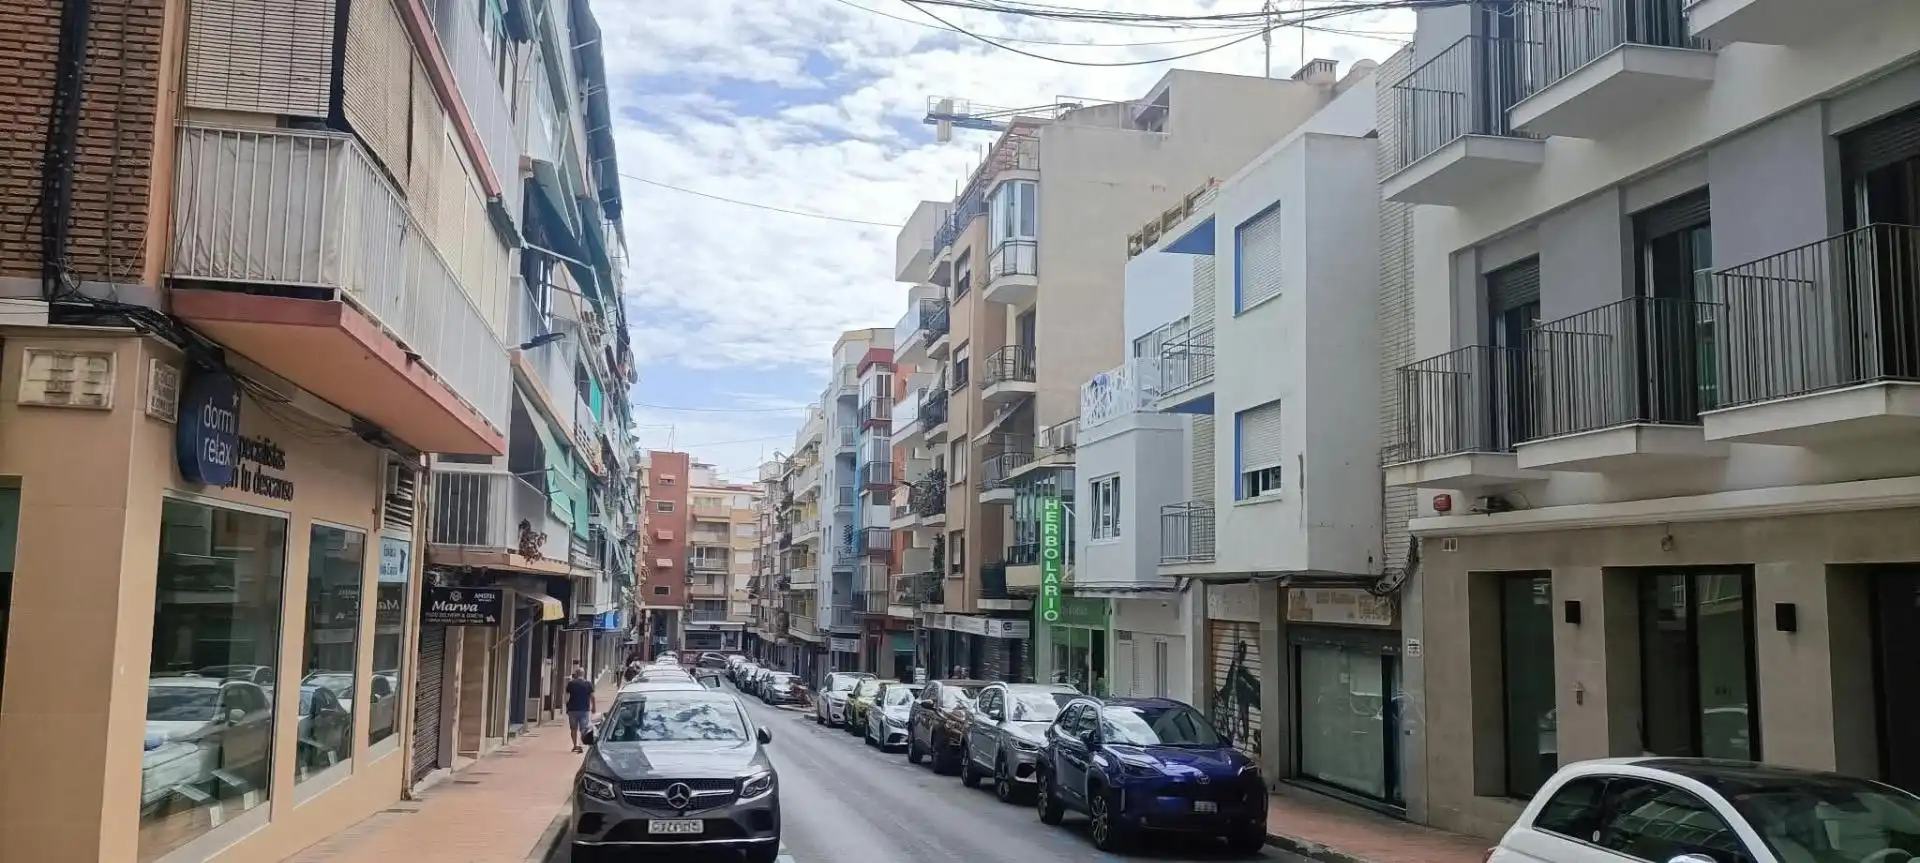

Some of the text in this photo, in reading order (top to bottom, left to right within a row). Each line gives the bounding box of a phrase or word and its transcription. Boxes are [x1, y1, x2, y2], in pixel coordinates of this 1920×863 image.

[203, 397, 235, 435] dormi
[203, 434, 232, 466] relax
[236, 434, 286, 471] pecialistas
[241, 463, 251, 493] tu
[253, 465, 294, 501] descanso
[1044, 499, 1058, 621] HERBOLARIO
[432, 600, 478, 612] Marwa
